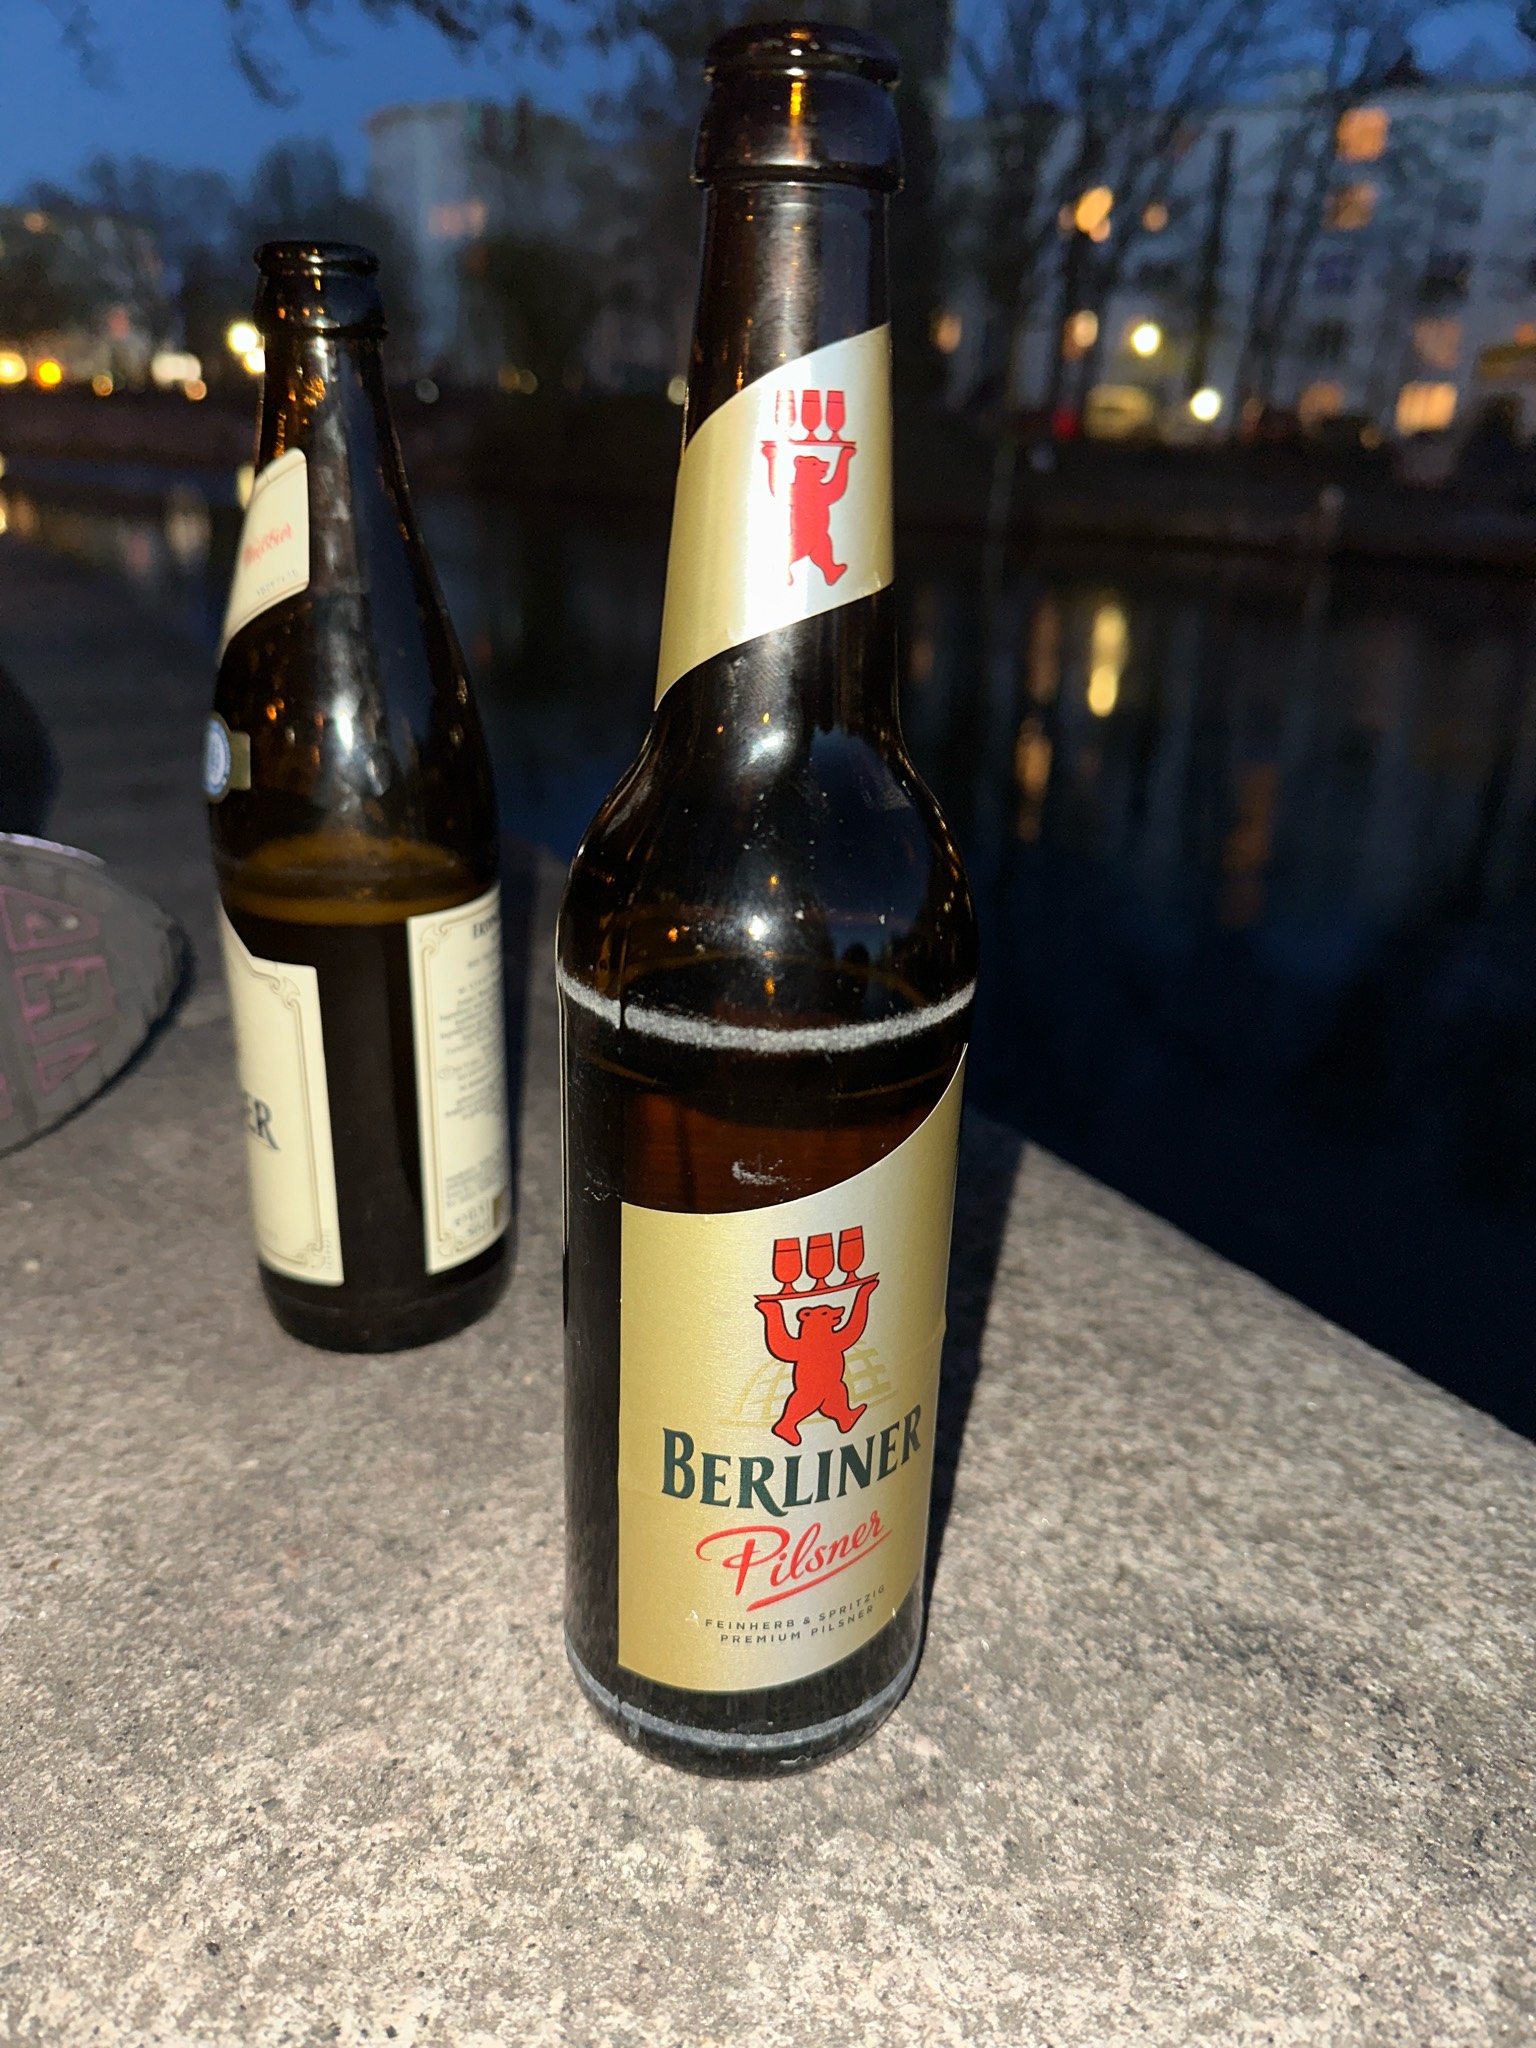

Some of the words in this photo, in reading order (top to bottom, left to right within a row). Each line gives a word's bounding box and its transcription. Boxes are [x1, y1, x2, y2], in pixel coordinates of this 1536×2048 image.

[661, 1404, 922, 1517] BERLINER
[695, 1509, 888, 1598] Pilsner
[705, 1617, 795, 1631] FEINHERB
[802, 1616, 811, 1625] &
[818, 1584, 886, 1622] SPRITZIG
[720, 1630, 801, 1643] PREMIUM
[810, 1604, 874, 1637] PILSNER
